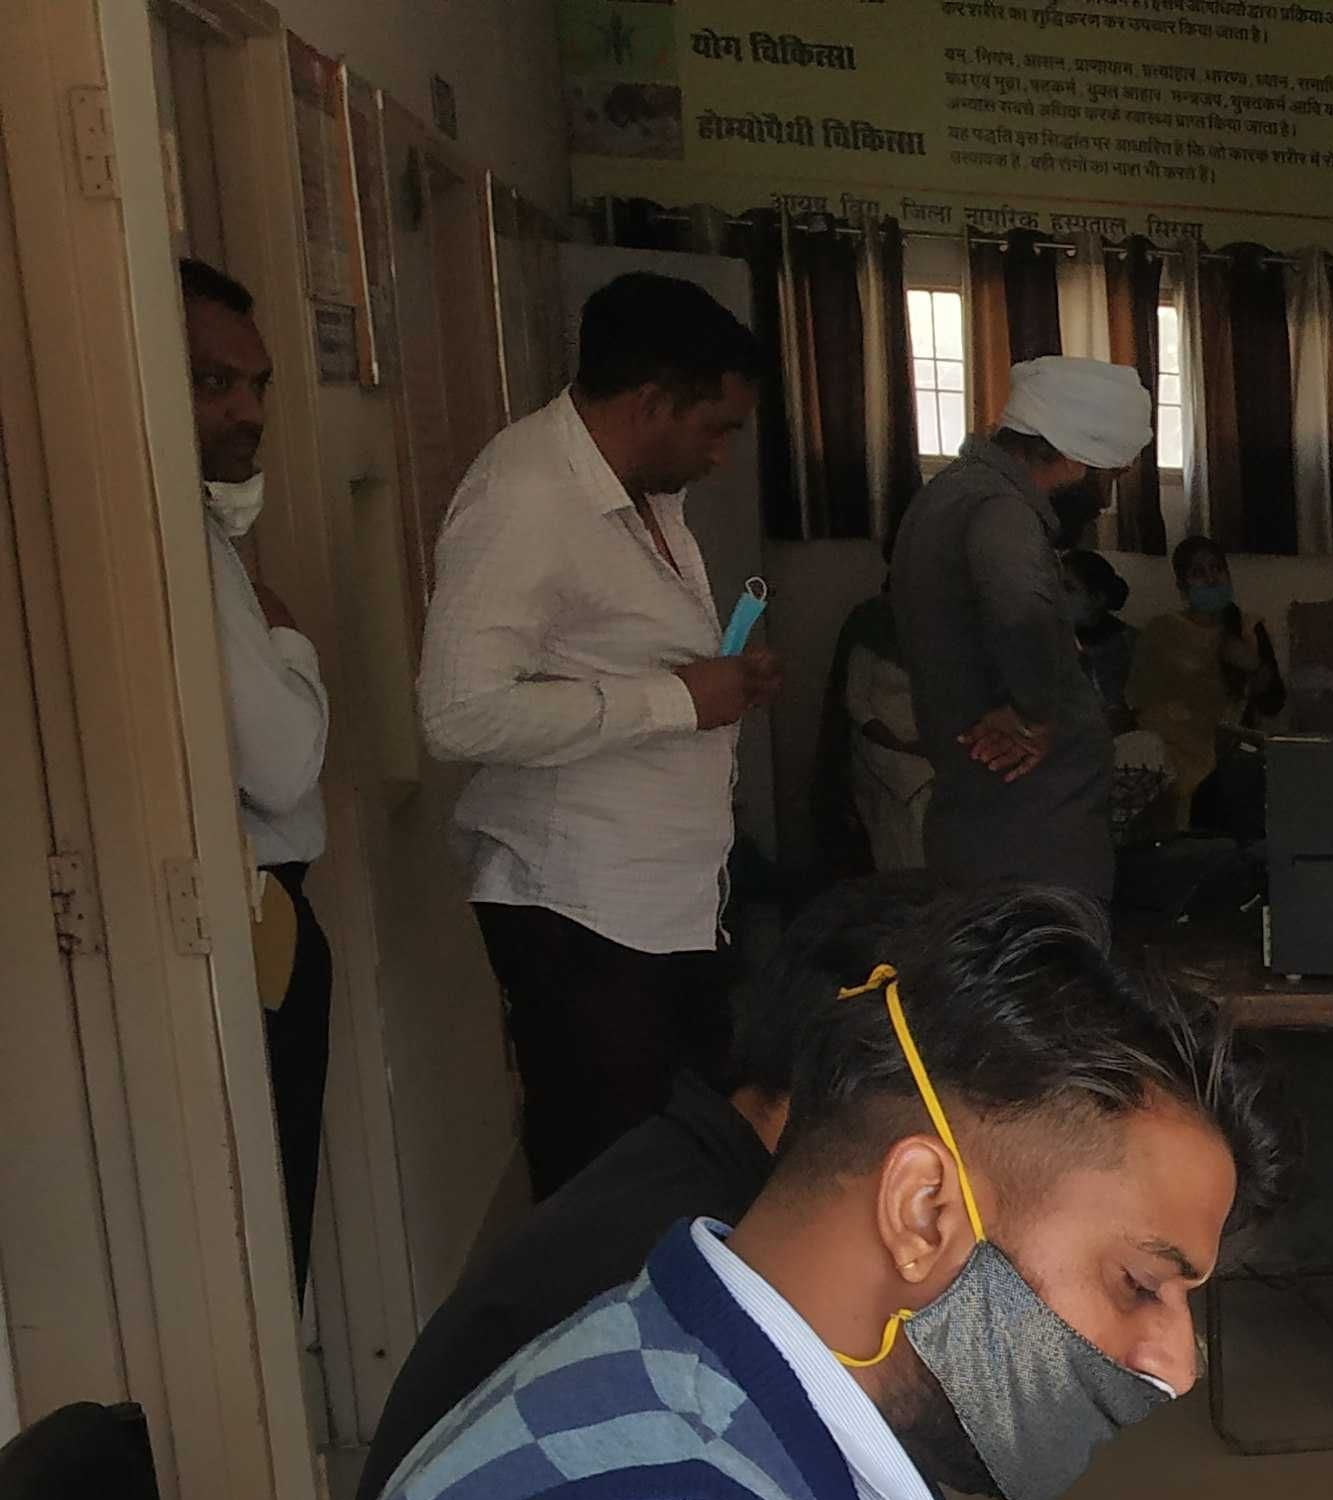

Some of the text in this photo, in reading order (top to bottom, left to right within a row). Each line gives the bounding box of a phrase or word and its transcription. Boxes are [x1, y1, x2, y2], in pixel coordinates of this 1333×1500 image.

[690, 27, 857, 71] योग चिकित्सा
[821, 115, 927, 156] चिकित्सा
